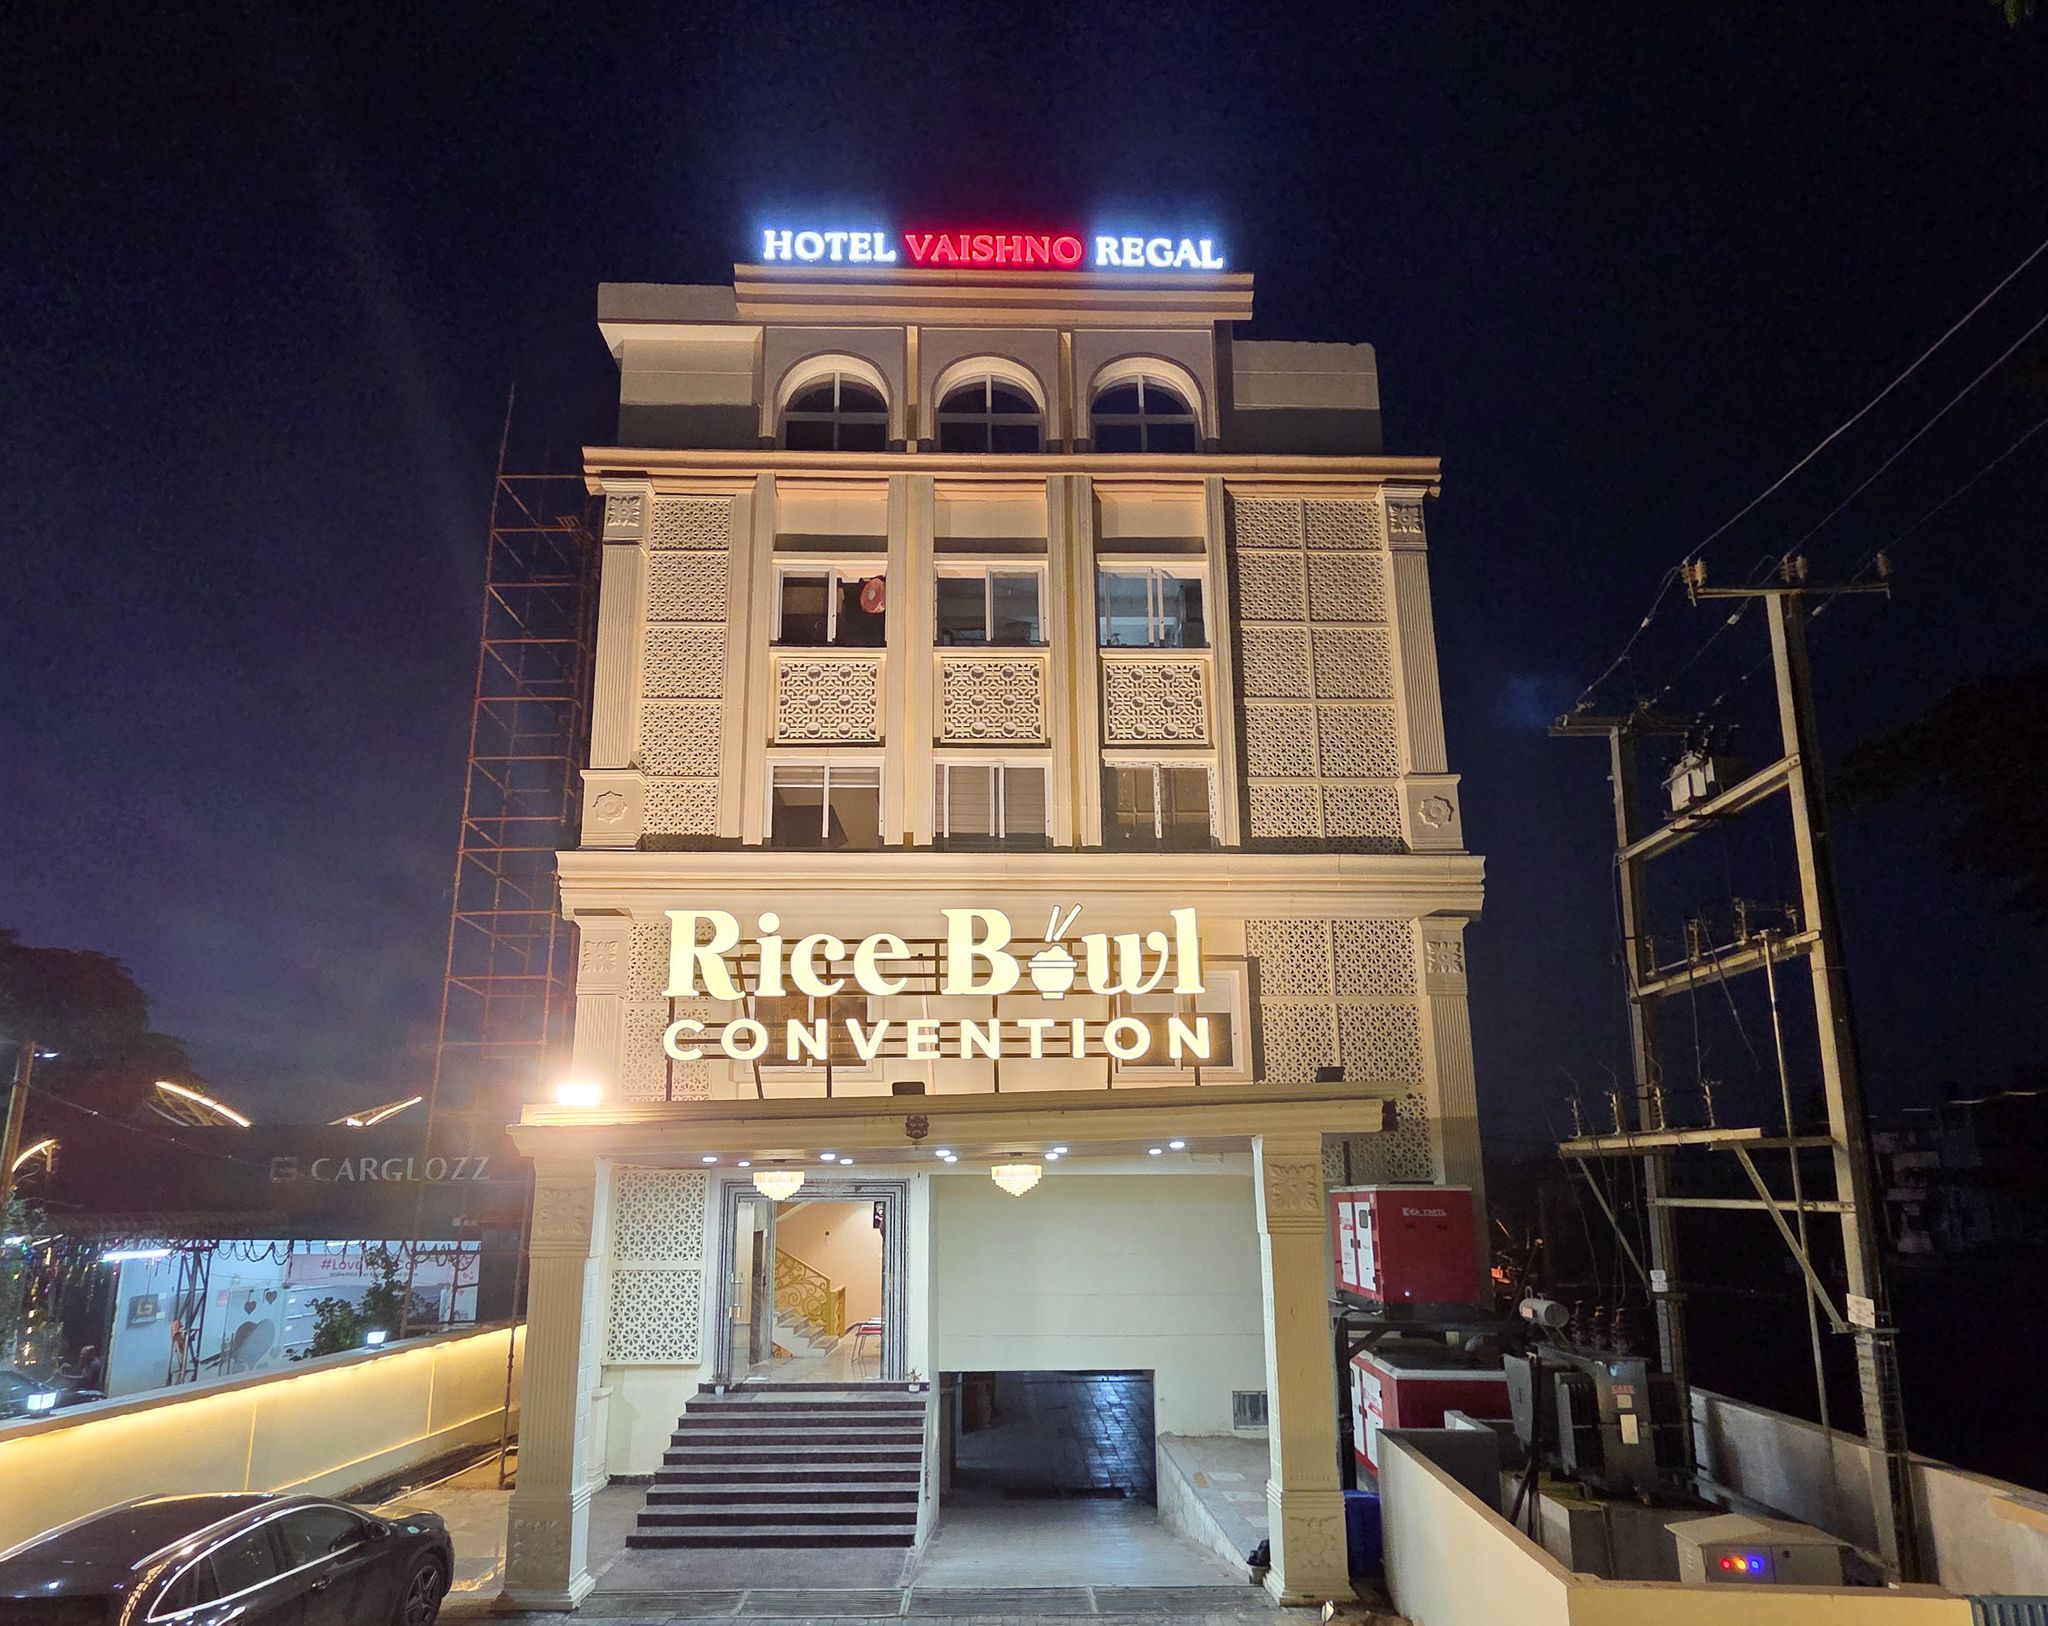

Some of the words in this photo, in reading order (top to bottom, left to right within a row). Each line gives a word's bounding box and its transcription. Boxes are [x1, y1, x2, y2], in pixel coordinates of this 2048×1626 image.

[763, 230, 897, 263] HOTEL
[905, 234, 1083, 264] VAISHNO
[1095, 236, 1224, 269] REGAL
[661, 908, 911, 1001] Rice
[662, 1016, 1211, 1061] CONVENTION
[311, 1157, 490, 1182] CARGLOZZ
